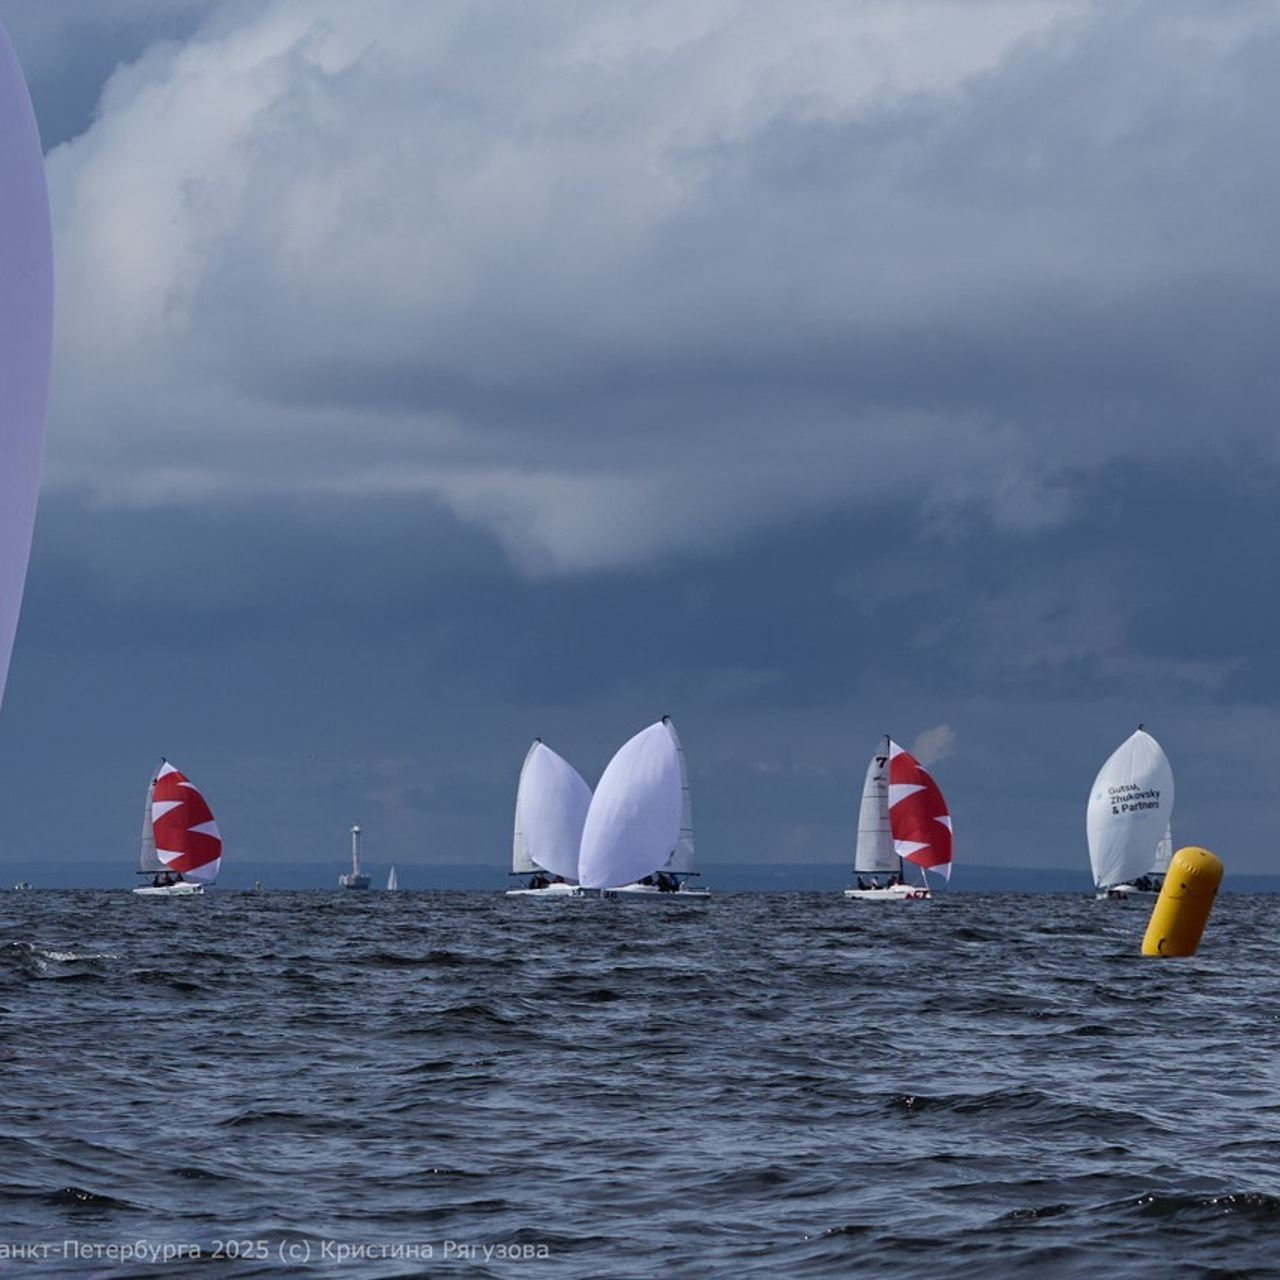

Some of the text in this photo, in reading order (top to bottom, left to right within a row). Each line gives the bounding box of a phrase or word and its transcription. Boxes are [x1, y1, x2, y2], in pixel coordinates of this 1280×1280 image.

[876, 757, 888, 768] 7
[1110, 789, 1160, 804] Zhukovsky
[1112, 802, 1160, 815] & Partners
